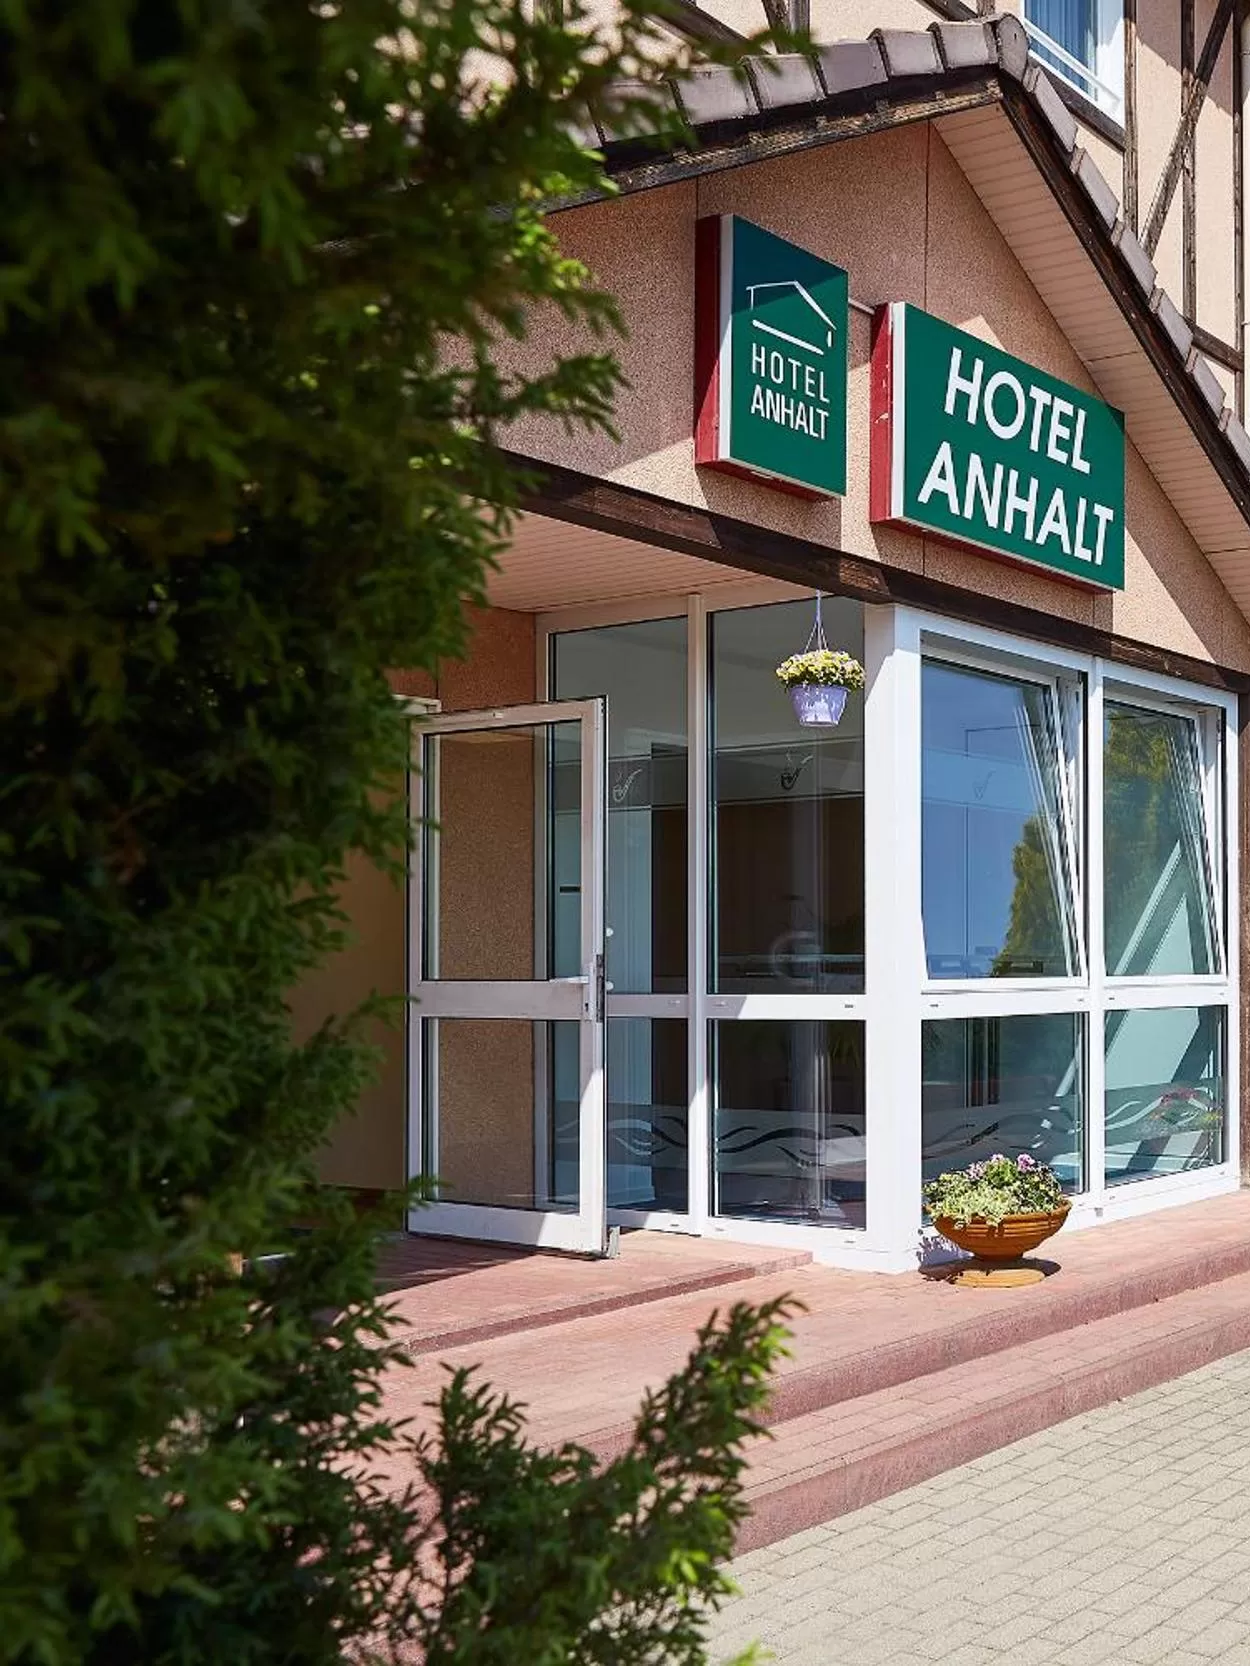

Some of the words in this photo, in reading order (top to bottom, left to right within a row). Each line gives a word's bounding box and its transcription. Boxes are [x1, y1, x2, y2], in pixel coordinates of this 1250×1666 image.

[750, 384, 829, 440] ANHALT
[752, 342, 830, 403] HOTEL
[944, 347, 1091, 474] HOTEL
[917, 441, 1114, 566] ANHALT
